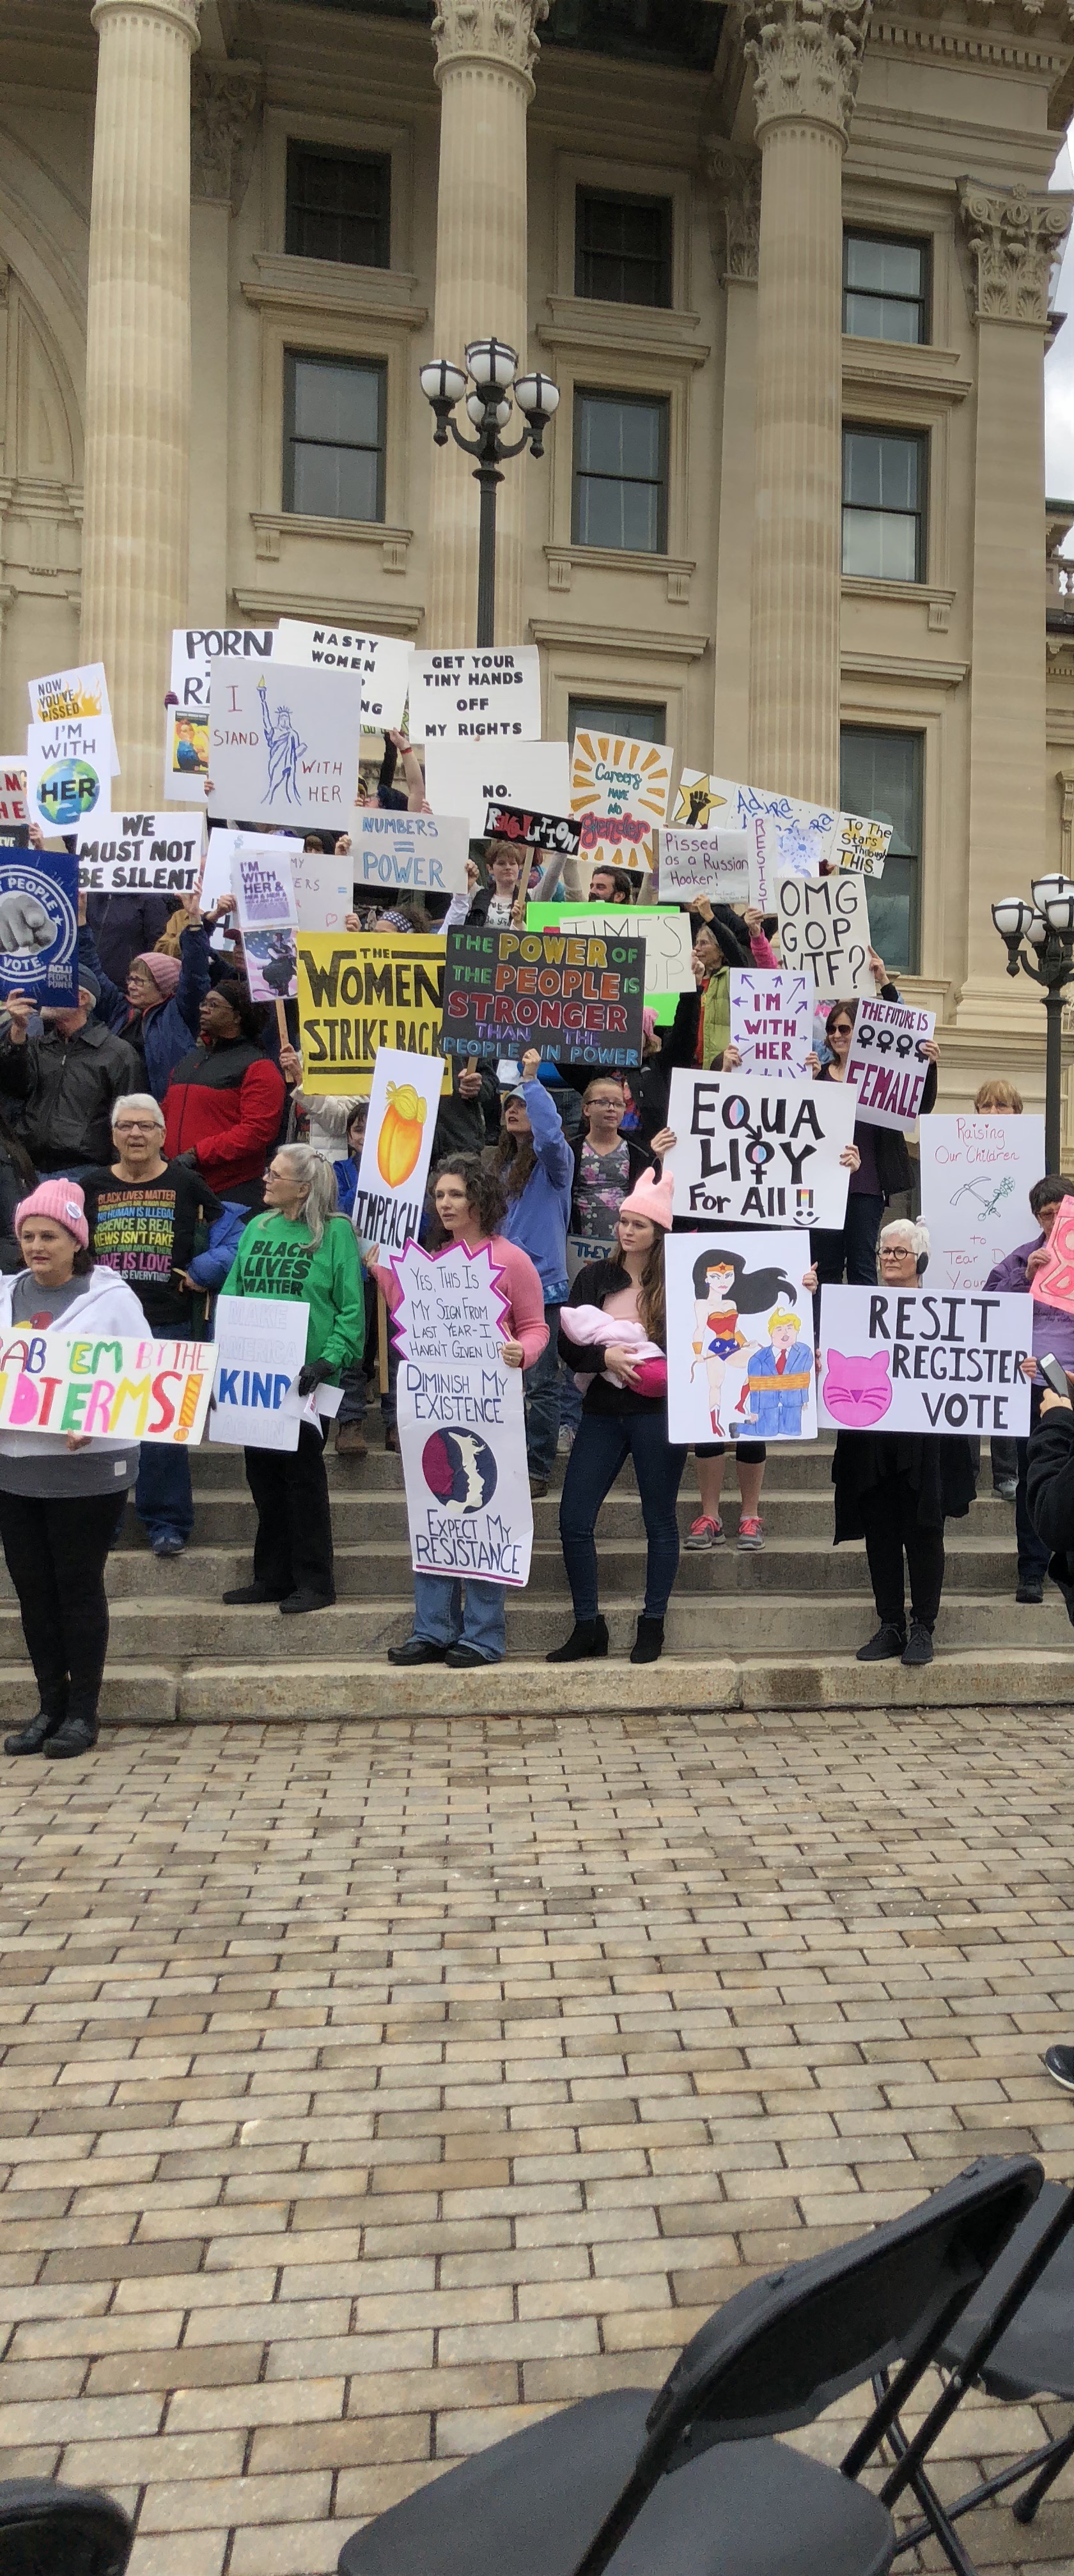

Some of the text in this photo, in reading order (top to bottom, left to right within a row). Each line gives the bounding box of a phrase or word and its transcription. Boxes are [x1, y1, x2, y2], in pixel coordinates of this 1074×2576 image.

[186, 630, 273, 659] PORN
[313, 630, 378, 653] NASTY
[312, 649, 375, 672] WOMEN
[432, 655, 515, 669] GET YOUR
[38, 678, 61, 695] NOW
[423, 672, 523, 687] TINY HANDS
[40, 689, 75, 709] YOU'VE
[226, 685, 242, 712] I
[456, 698, 489, 711] OFF
[42, 702, 79, 722] PISSED
[56, 724, 82, 740] I'M
[214, 729, 259, 747] STAND
[425, 722, 522, 736] MY RIGHTS
[41, 739, 96, 759] WITH
[302, 759, 343, 775] WITH
[41, 778, 96, 803] HER
[309, 785, 342, 803] HER
[482, 784, 512, 798] NO.
[607, 802, 623, 815] NO
[123, 814, 155, 836] WE
[362, 817, 439, 837] NUMBERS
[580, 812, 651, 849] gender
[844, 818, 864, 832] To
[868, 822, 892, 839] The
[665, 832, 719, 852] Pissed
[841, 833, 878, 847] Stars
[80, 840, 196, 862] MUST NOT
[240, 861, 259, 872] I'M
[291, 858, 304, 868] MY
[363, 851, 446, 888] POWER
[665, 853, 749, 871] as a Russian
[755, 818, 768, 913] RESIST
[79, 867, 198, 890] BE SILENT
[242, 871, 276, 882] WITH
[293, 878, 320, 891] ERS
[670, 869, 719, 887] Hooker!
[8, 878, 58, 911] PEOPLE
[244, 883, 271, 894] HER
[780, 880, 857, 917] OMG
[781, 918, 852, 952] GOP
[360, 948, 390, 959] THE
[452, 933, 638, 968] THE POWER OF
[4, 957, 41, 971] VOTE
[299, 950, 446, 1008] WOMEN
[452, 963, 640, 1000] THE PEOPLE IS
[448, 990, 628, 1033] STRONGER
[754, 993, 781, 1012] I'M
[862, 1000, 929, 1032] THE FUTURE IS
[475, 1023, 602, 1047] THAN THE
[743, 1020, 797, 1037] WITH
[304, 1018, 447, 1062] STRIKE BACK
[755, 1041, 793, 1060] HER
[442, 1037, 639, 1066] PEOPLE IN POWER
[846, 1060, 924, 1119] FEMALE
[956, 1118, 1005, 1150] Raising
[935, 1145, 1020, 1164] Our Children
[98, 1191, 121, 1205] BLACK
[123, 1190, 144, 1201] LIVES
[144, 1190, 176, 1201] MATTER
[689, 1182, 731, 1213] For
[740, 1186, 786, 1218] All
[107, 1207, 135, 1220] HUMAN
[136, 1207, 144, 1216] IS
[145, 1207, 175, 1220] ILLEGAL
[357, 1190, 419, 1250] IMPEACH
[96, 1218, 174, 1233] SCIENCE IS REAL
[94, 1231, 175, 1247] NEWS ISN'T FAKE
[970, 1235, 986, 1245] to
[250, 1241, 314, 1262] BLACK
[571, 1241, 611, 1259] THEY
[943, 1250, 978, 1265] Tear
[123, 1252, 137, 1269] IS
[139, 1253, 173, 1273] LOVE
[244, 1257, 311, 1280] LIVES
[130, 1270, 171, 1283] EVERYTHING
[410, 1266, 479, 1292] YES, THIS IS
[244, 1278, 304, 1298] MATTER
[228, 1301, 288, 1330] MAKE
[411, 1297, 488, 1321] MY SIGN FROM
[869, 1295, 1000, 1342] RESIT
[412, 1324, 437, 1338] LAST
[0, 1337, 214, 1374] AB 'EM BY THE
[219, 1335, 298, 1366] AMERICA
[410, 1340, 506, 1360] HAVEN'T GIVEN UP
[892, 1344, 1028, 1384] REGISTER
[219, 1368, 292, 1409] KIND
[407, 1364, 508, 1396] DIMINISH MY
[415, 1393, 504, 1424] EXISTENCE
[921, 1393, 1009, 1429] VOTE
[225, 1415, 284, 1445] AGAIN
[427, 1509, 511, 1543] EXPECT MY
[416, 1535, 522, 1574] RESISTANCE
